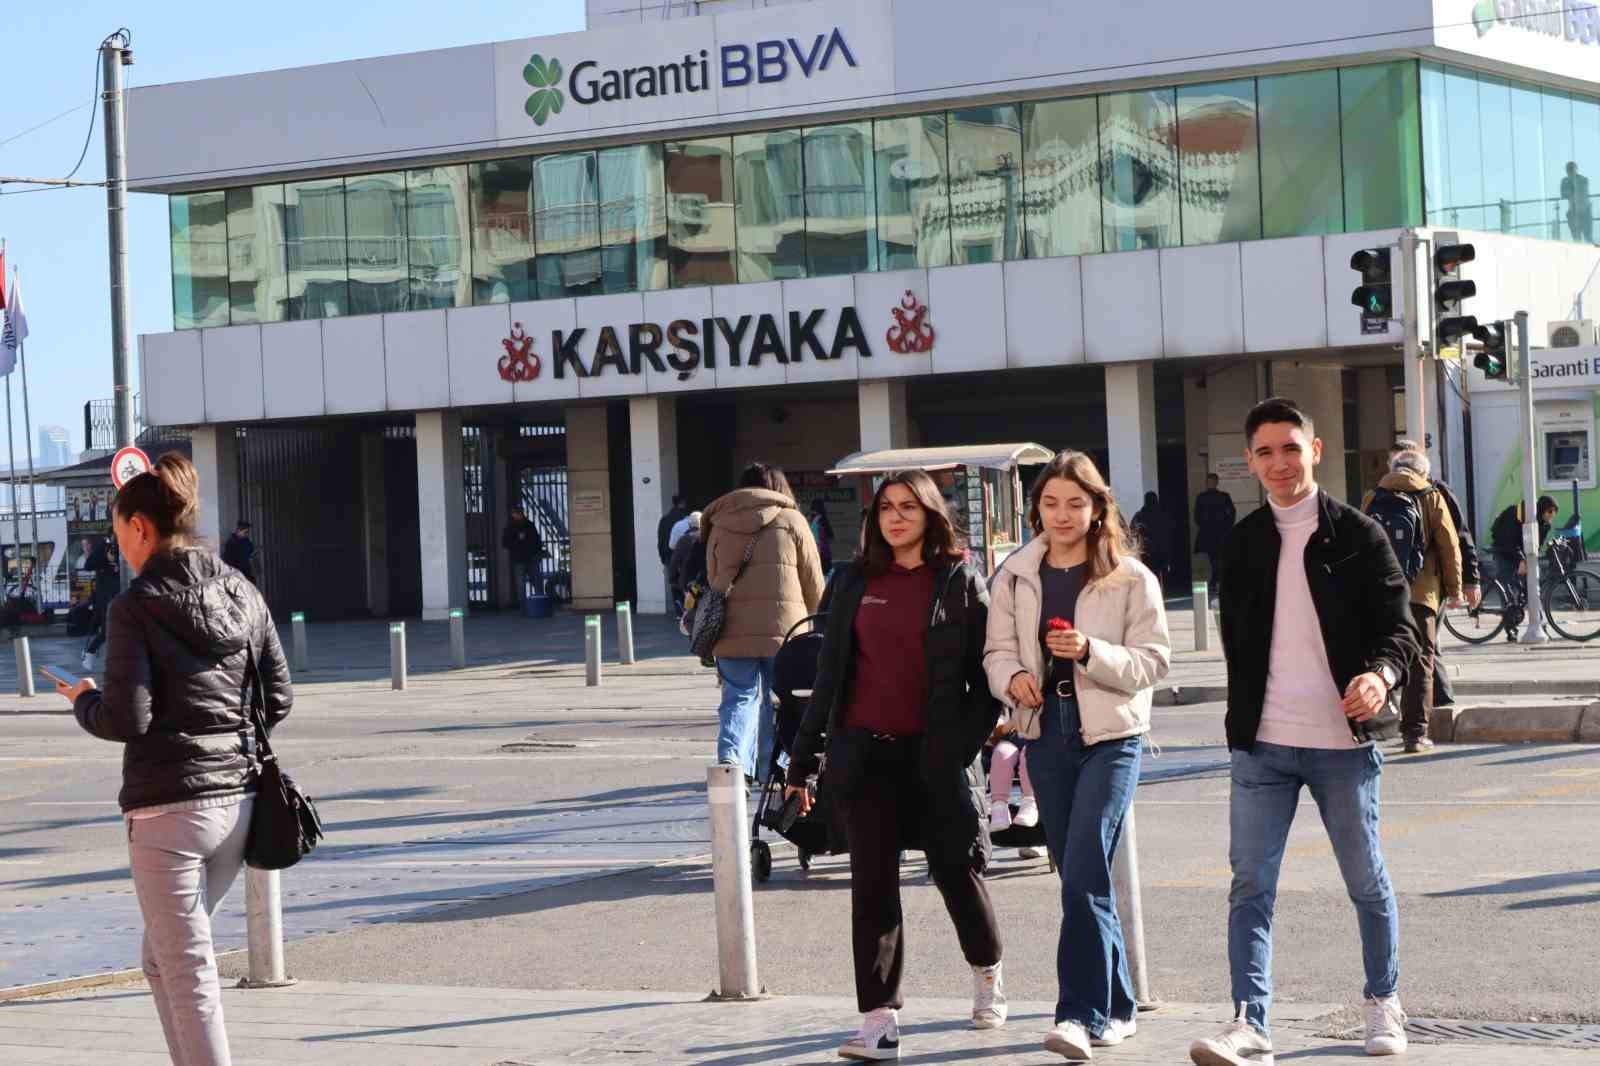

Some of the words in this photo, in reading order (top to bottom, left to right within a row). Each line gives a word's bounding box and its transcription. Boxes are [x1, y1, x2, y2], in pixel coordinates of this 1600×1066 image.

[568, 49, 709, 105] Garanti
[720, 26, 857, 88] BBVA
[551, 306, 872, 381] KARŞIYAKA
